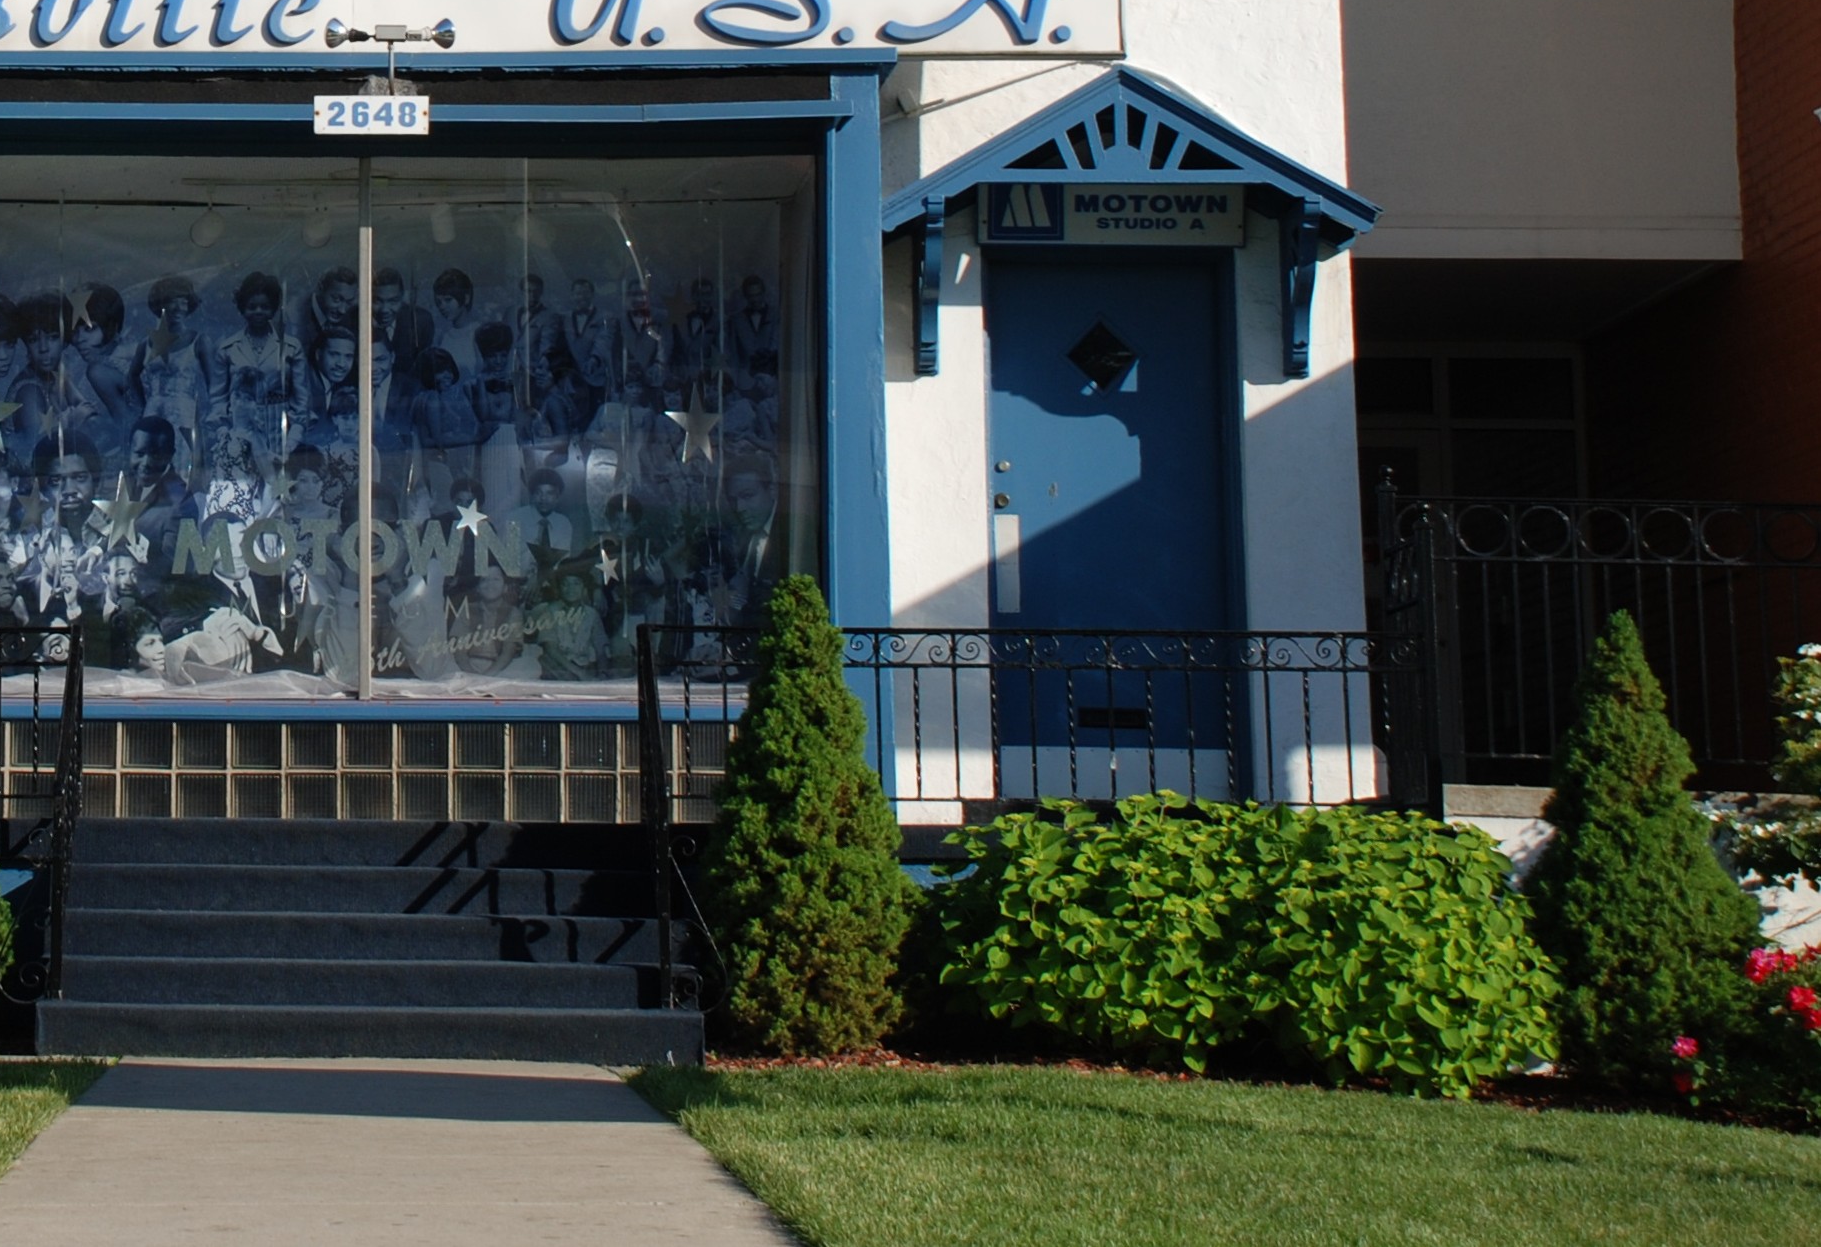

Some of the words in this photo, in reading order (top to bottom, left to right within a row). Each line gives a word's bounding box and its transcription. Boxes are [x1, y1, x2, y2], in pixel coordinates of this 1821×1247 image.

[327, 101, 416, 127] 2648
[1074, 194, 1227, 213] MOTOWN
[1096, 217, 1177, 230] STUDIO
[1189, 217, 1205, 230] A
[171, 518, 521, 577] MOTOWN
[416, 606, 585, 663] Anniversary
